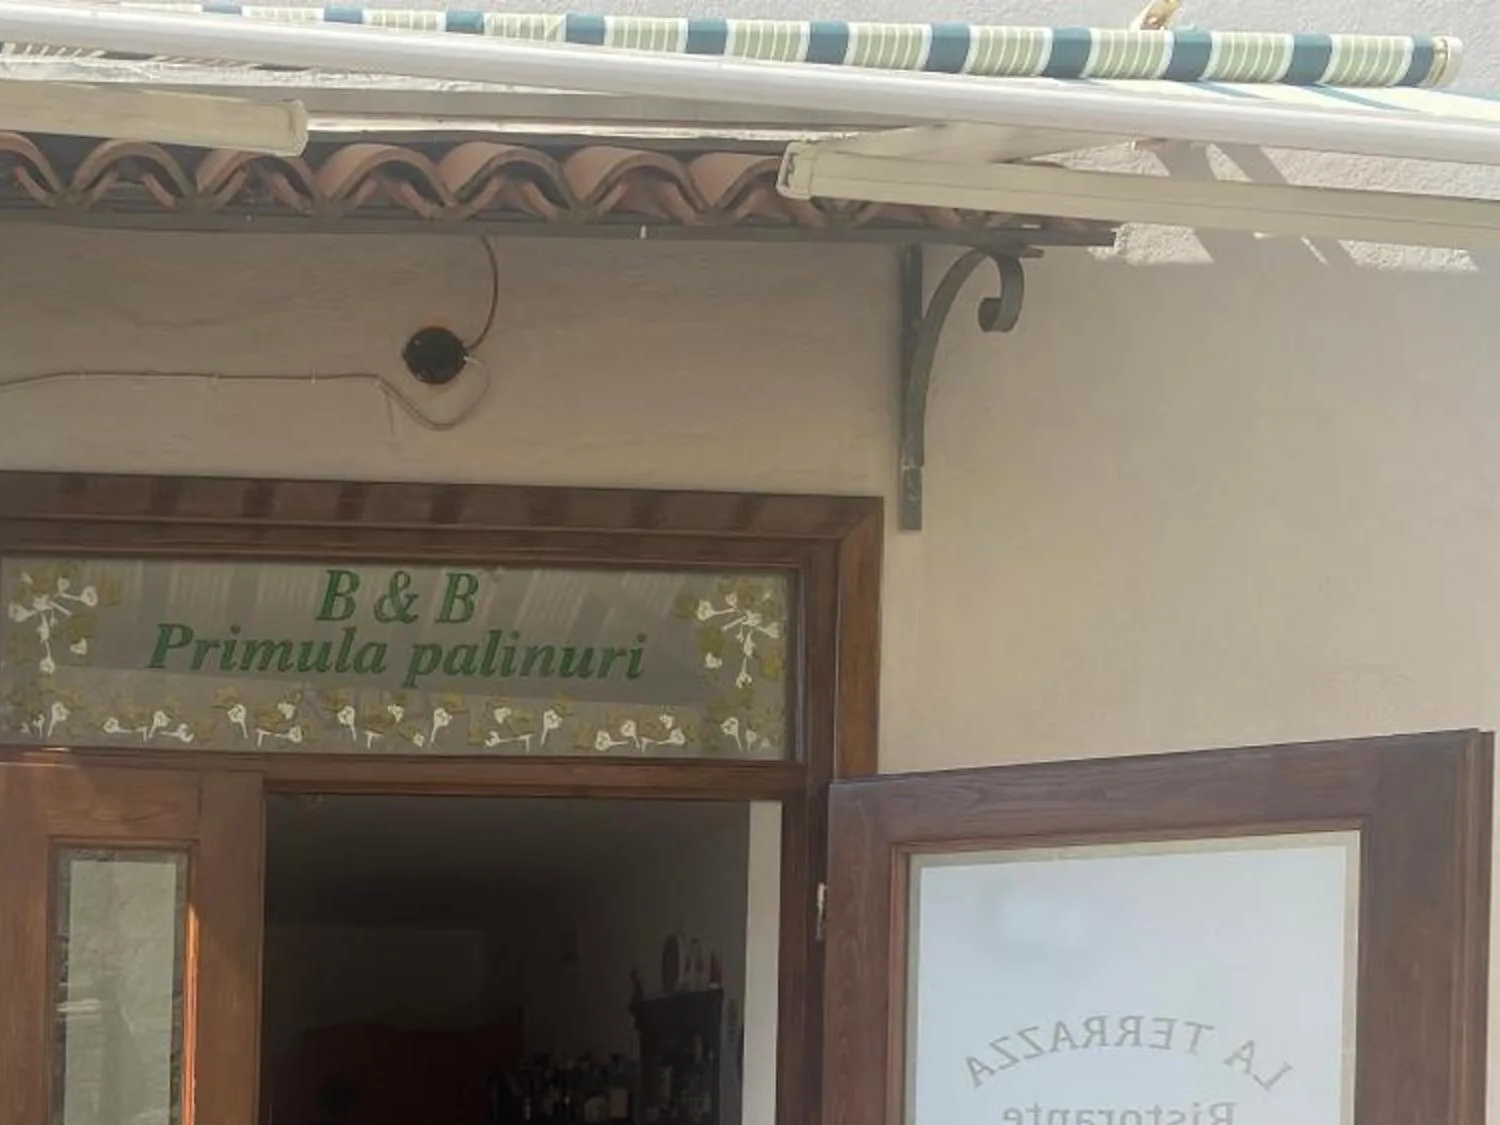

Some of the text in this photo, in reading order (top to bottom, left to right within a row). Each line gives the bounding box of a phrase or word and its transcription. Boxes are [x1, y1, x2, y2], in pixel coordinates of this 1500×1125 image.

[315, 568, 479, 624] B & B
[148, 622, 647, 689] Primula palinuri
